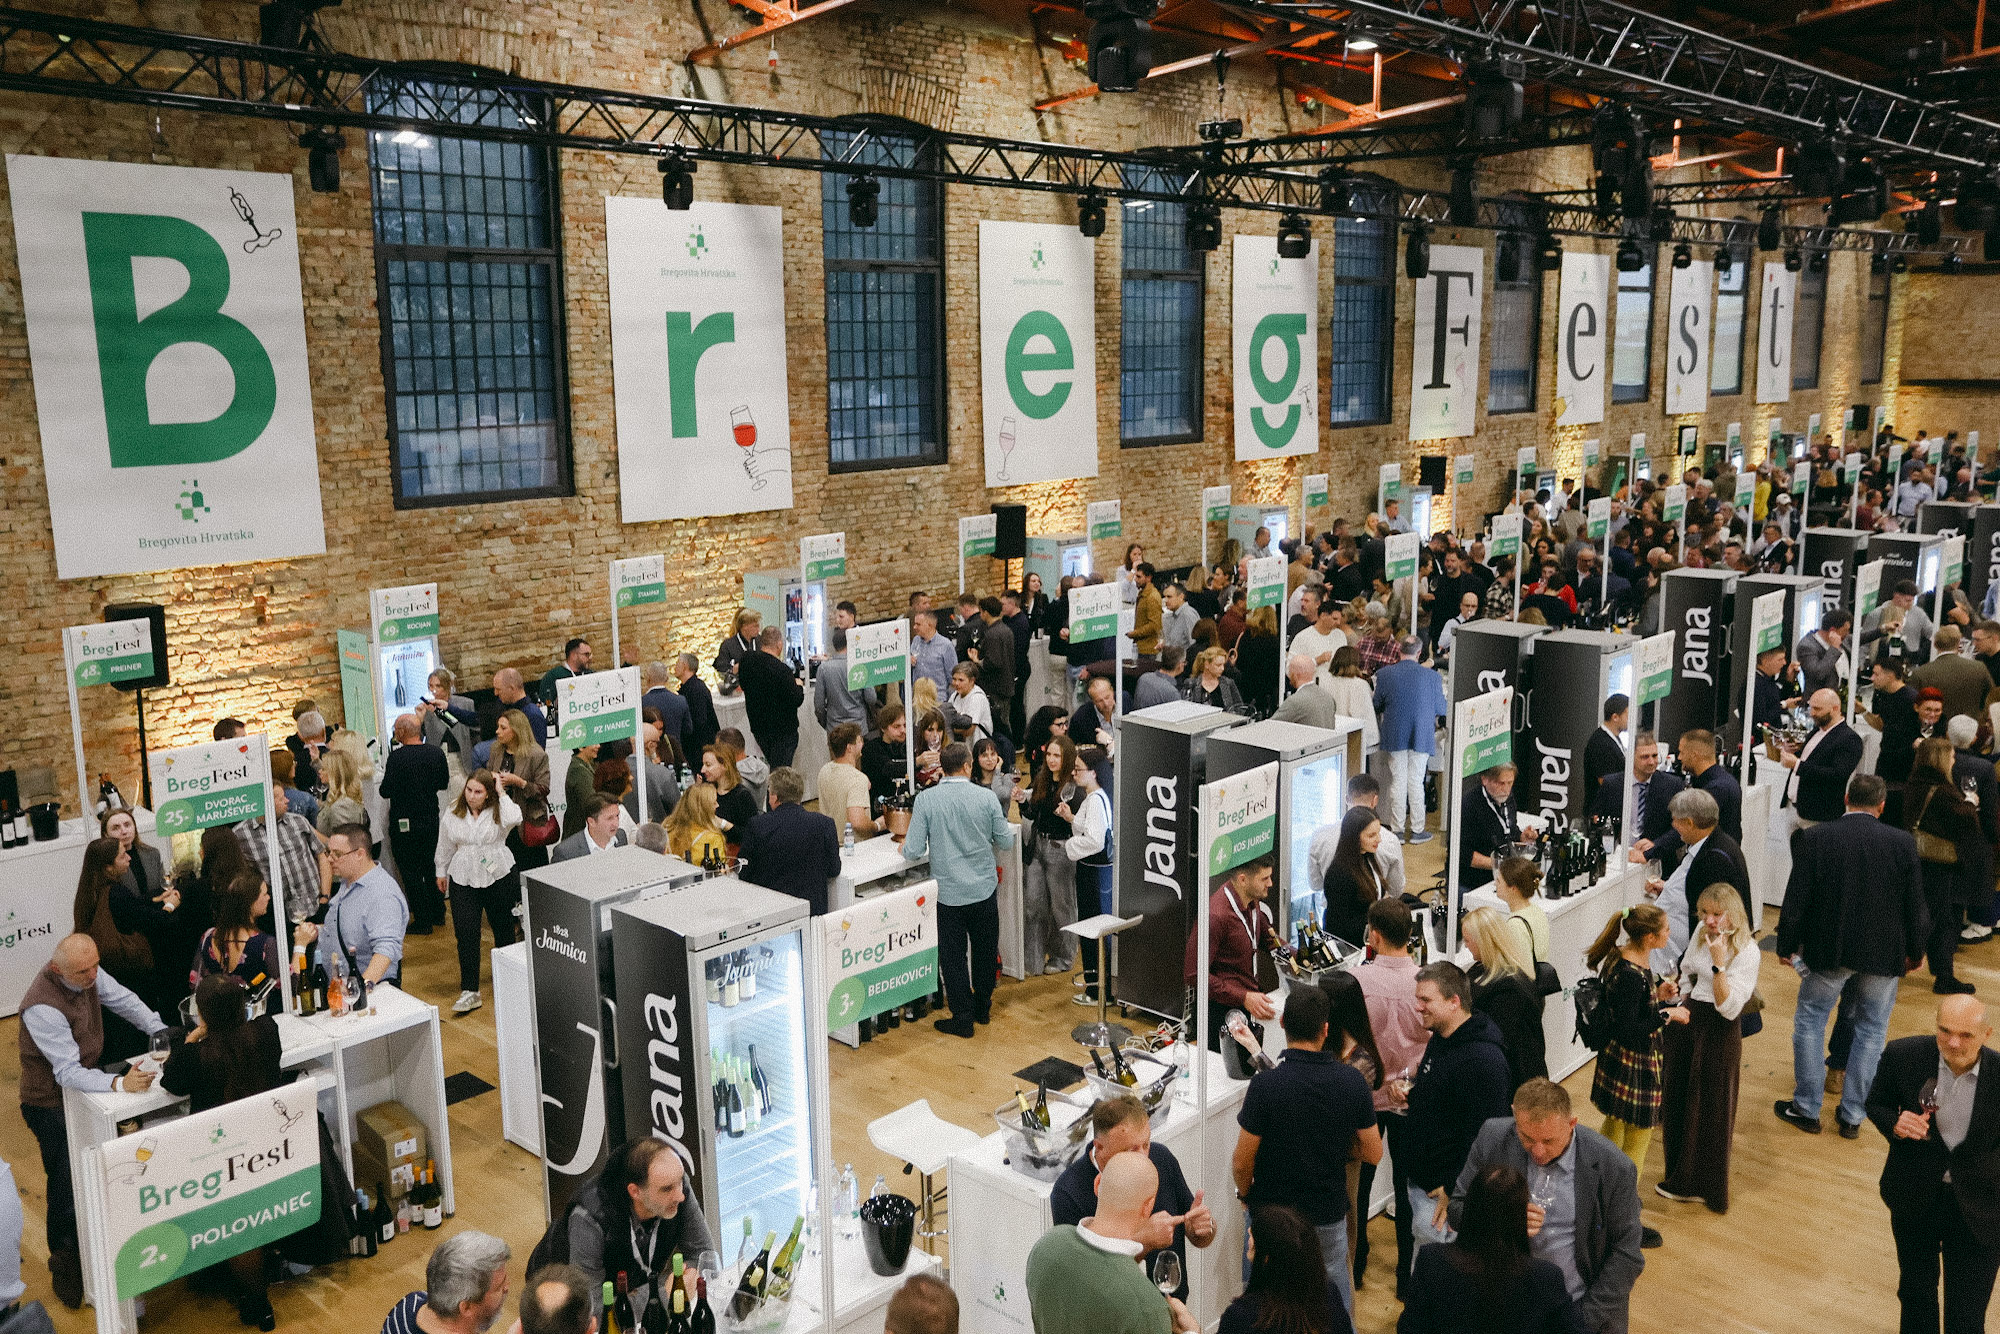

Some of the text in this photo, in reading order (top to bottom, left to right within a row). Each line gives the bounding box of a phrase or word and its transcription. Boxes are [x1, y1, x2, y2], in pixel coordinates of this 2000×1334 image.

[82, 211, 277, 468] B
[1423, 270, 1474, 390] F
[1566, 302, 1597, 381] e
[1677, 304, 1699, 375] s
[1769, 286, 1785, 368] t
[666, 311, 735, 439] r
[1005, 310, 1074, 420] e
[1249, 313, 1307, 449] g
[139, 529, 254, 549] Bregovita Hrvatska
[621, 571, 658, 584] BregFest
[1821, 559, 1844, 614] ana
[385, 602, 430, 616] BregFest
[1076, 601, 1112, 616] BregFest
[383, 621, 432, 637] 49. KOCIJAN
[1681, 605, 1712, 686] Jana
[82, 638, 141, 657] BregFest
[855, 641, 899, 659] BregFest
[81, 662, 142, 680] 48. PREINER
[852, 664, 897, 683] 27. NAJMAN
[569, 692, 625, 714] BregFest
[566, 719, 631, 740] 26. PZ IVANEC
[1469, 714, 1505, 738] BregFest
[167, 764, 249, 793] BregFest
[1536, 737, 1571, 835] Jana
[164, 809, 190, 826] 25.
[196, 801, 258, 824] MARUŠEVEC
[204, 794, 248, 811] DVORAC
[1218, 795, 1268, 828] BregFest
[1144, 774, 1182, 901] Jana
[1215, 828, 1272, 865] 4. KOS JURIŠIĆ
[535, 928, 588, 964] Jamnica
[552, 925, 570, 938] 1828
[841, 923, 924, 969] BregFest
[839, 963, 933, 1017] 3. BEDEKOVICH
[644, 992, 696, 1177] Jana
[138, 1137, 295, 1214] BregFest
[138, 1190, 312, 1270] 2. POLOVANEC
